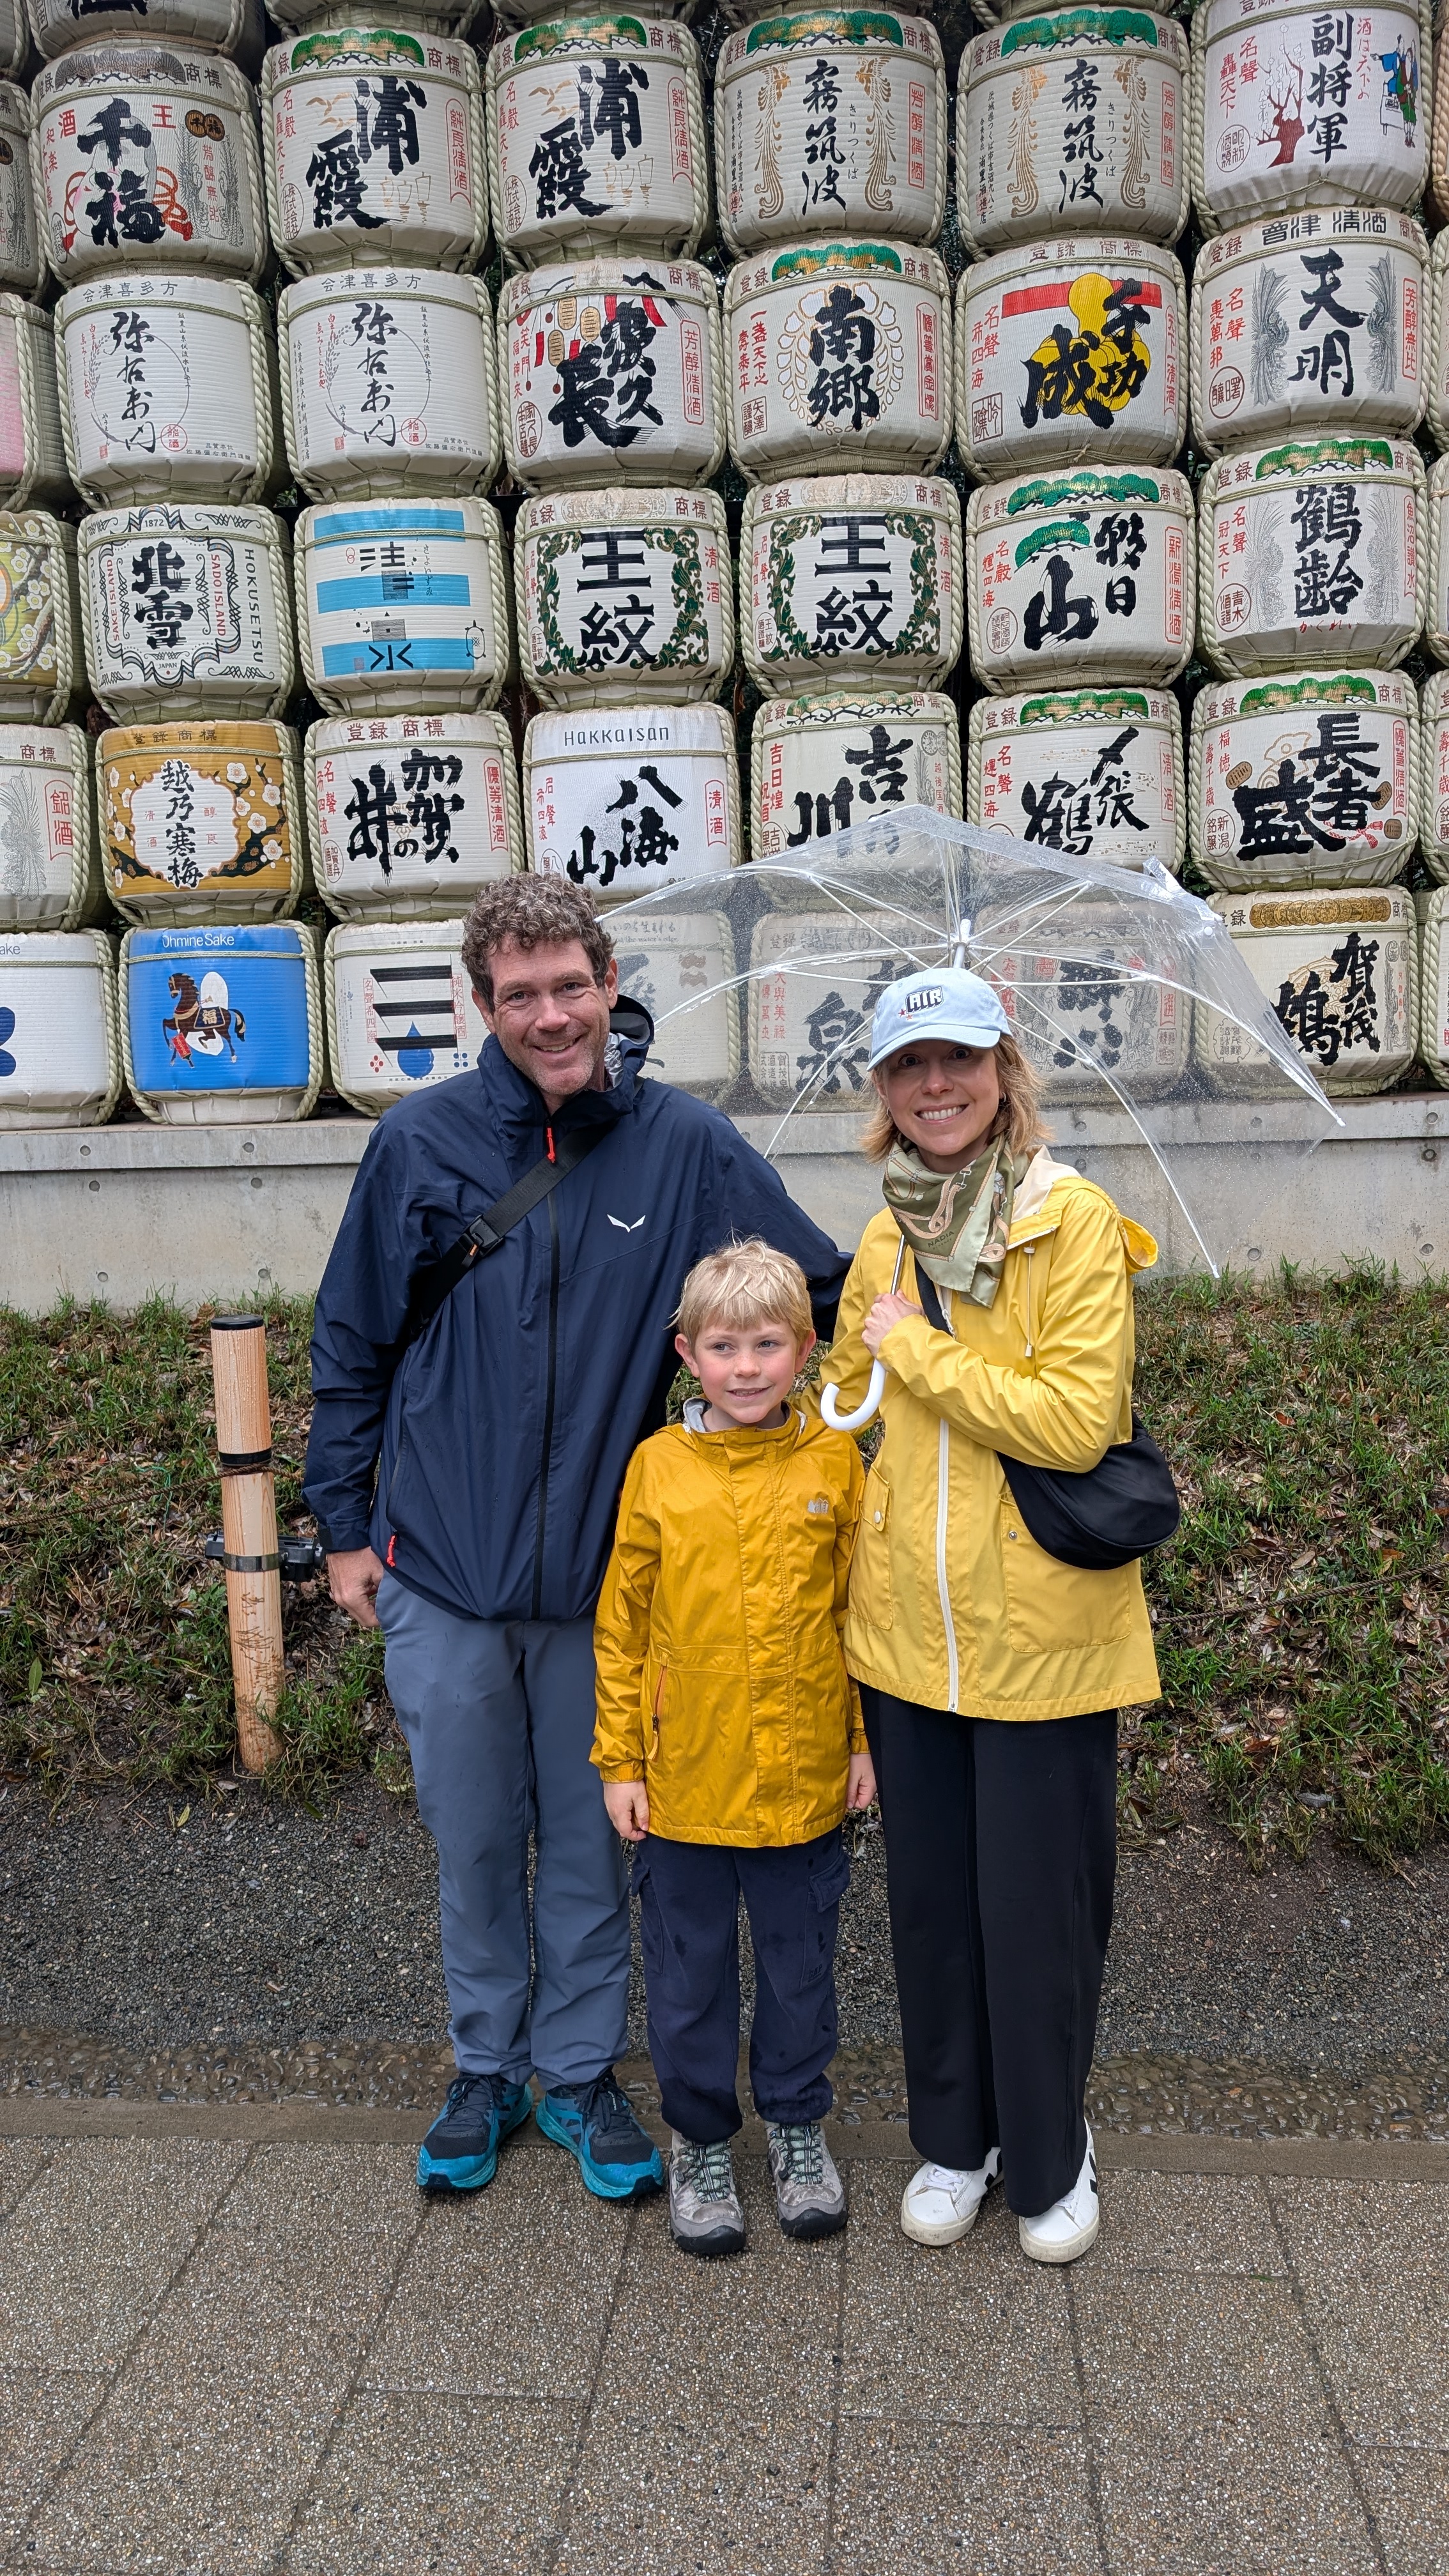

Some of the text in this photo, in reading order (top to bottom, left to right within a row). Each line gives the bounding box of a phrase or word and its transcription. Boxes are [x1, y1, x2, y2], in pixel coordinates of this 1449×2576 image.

[427, 47, 461, 77] 商標
[904, 26, 932, 55] 商標
[974, 38, 1000, 67] 登録
[1356, 17, 1372, 100] 酒は天下の
[184, 63, 222, 89] 商標
[1306, 10, 1354, 164] 副将軍
[58, 104, 176, 139] 酒 王
[528, 58, 649, 220] 浦霞
[801, 58, 847, 216] 霧筑波
[847, 104, 859, 180] きりつくば
[1059, 58, 1105, 213] 霧筑波
[1106, 102, 1117, 178] きりつくば
[77, 95, 167, 249] 千福
[306, 75, 427, 229] 浦霞
[1030, 241, 1142, 263] 登録 商標
[1210, 236, 1242, 268] 登録
[1262, 215, 1322, 246] 會津
[1332, 209, 1386, 233] 清酒
[82, 281, 178, 303] 会津喜多方
[321, 273, 421, 291] 会津喜多方
[668, 266, 701, 291] 商標
[740, 257, 931, 296] 登録 商標
[1287, 247, 1369, 397] 天明
[1405, 288, 1416, 372] 芳醇無比
[685, 330, 701, 417] 芳醇清酒
[1160, 484, 1181, 505] 商標
[1218, 461, 1254, 491] 登録
[674, 496, 707, 519] 商標
[762, 489, 792, 514] 登録
[915, 484, 942, 508] 商標
[144, 519, 164, 528] 1872
[107, 559, 117, 605] ISLAND
[705, 546, 719, 603] 清酒
[811, 516, 895, 653] 王紋
[940, 535, 951, 593] 清酒
[89, 556, 103, 670] HOKUSETSU
[131, 541, 194, 650] 北雪
[211, 554, 226, 636] SADO ISLAND
[245, 548, 263, 663] HOKUSETSU
[576, 530, 658, 667] 王紋
[1220, 594, 1231, 626] 酒造
[1231, 590, 1245, 622] 青木
[1299, 619, 1360, 634] かくれい
[985, 707, 1017, 731] 登録
[1206, 684, 1403, 722] 登録 商標
[347, 719, 445, 742] 登録 商標
[20, 744, 56, 762] 商標
[1162, 752, 1173, 811] 清酒
[1232, 712, 1381, 861] 長者盛
[50, 789, 73, 846] 銘酒
[144, 810, 157, 848] 清酒
[160, 760, 204, 887] 越乃寒梅
[567, 765, 688, 887] 八海山
[709, 790, 723, 834] 清酒
[0, 945, 20, 956] ake
[162, 933, 234, 948] Ohmine Sake
[907, 987, 942, 1011] AIR
[928, 1231, 954, 1248] NADIA
